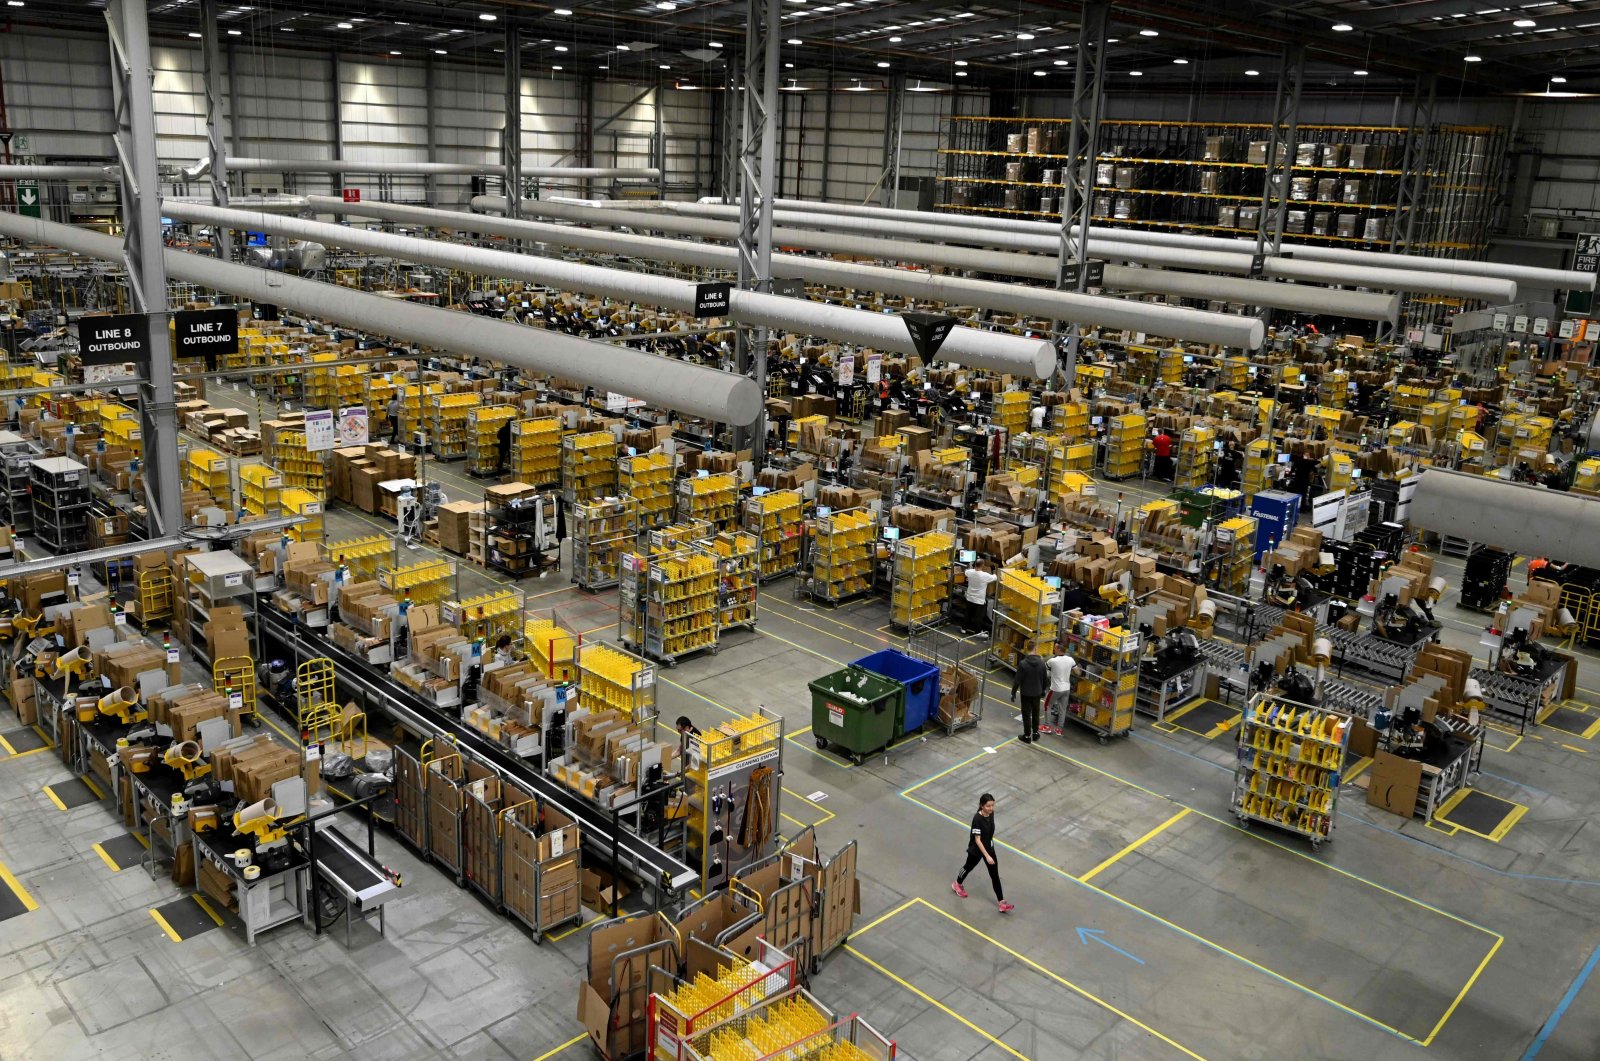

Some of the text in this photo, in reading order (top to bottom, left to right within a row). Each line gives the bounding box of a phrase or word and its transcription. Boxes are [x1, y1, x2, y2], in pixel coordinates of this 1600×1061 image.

[1578, 255, 1598, 264] FIRE
[1576, 263, 1596, 271] EXIT
[704, 292, 717, 300] LINE
[699, 301, 726, 309] OUTBOUND
[190, 322, 223, 333] LINE 7
[95, 328, 132, 340] LINE 8
[183, 334, 232, 345] OUTBOUND
[88, 340, 141, 352] OUTBOUND
[1252, 510, 1280, 522] FASTENAL
[735, 751, 779, 769] CLEANING STATION
